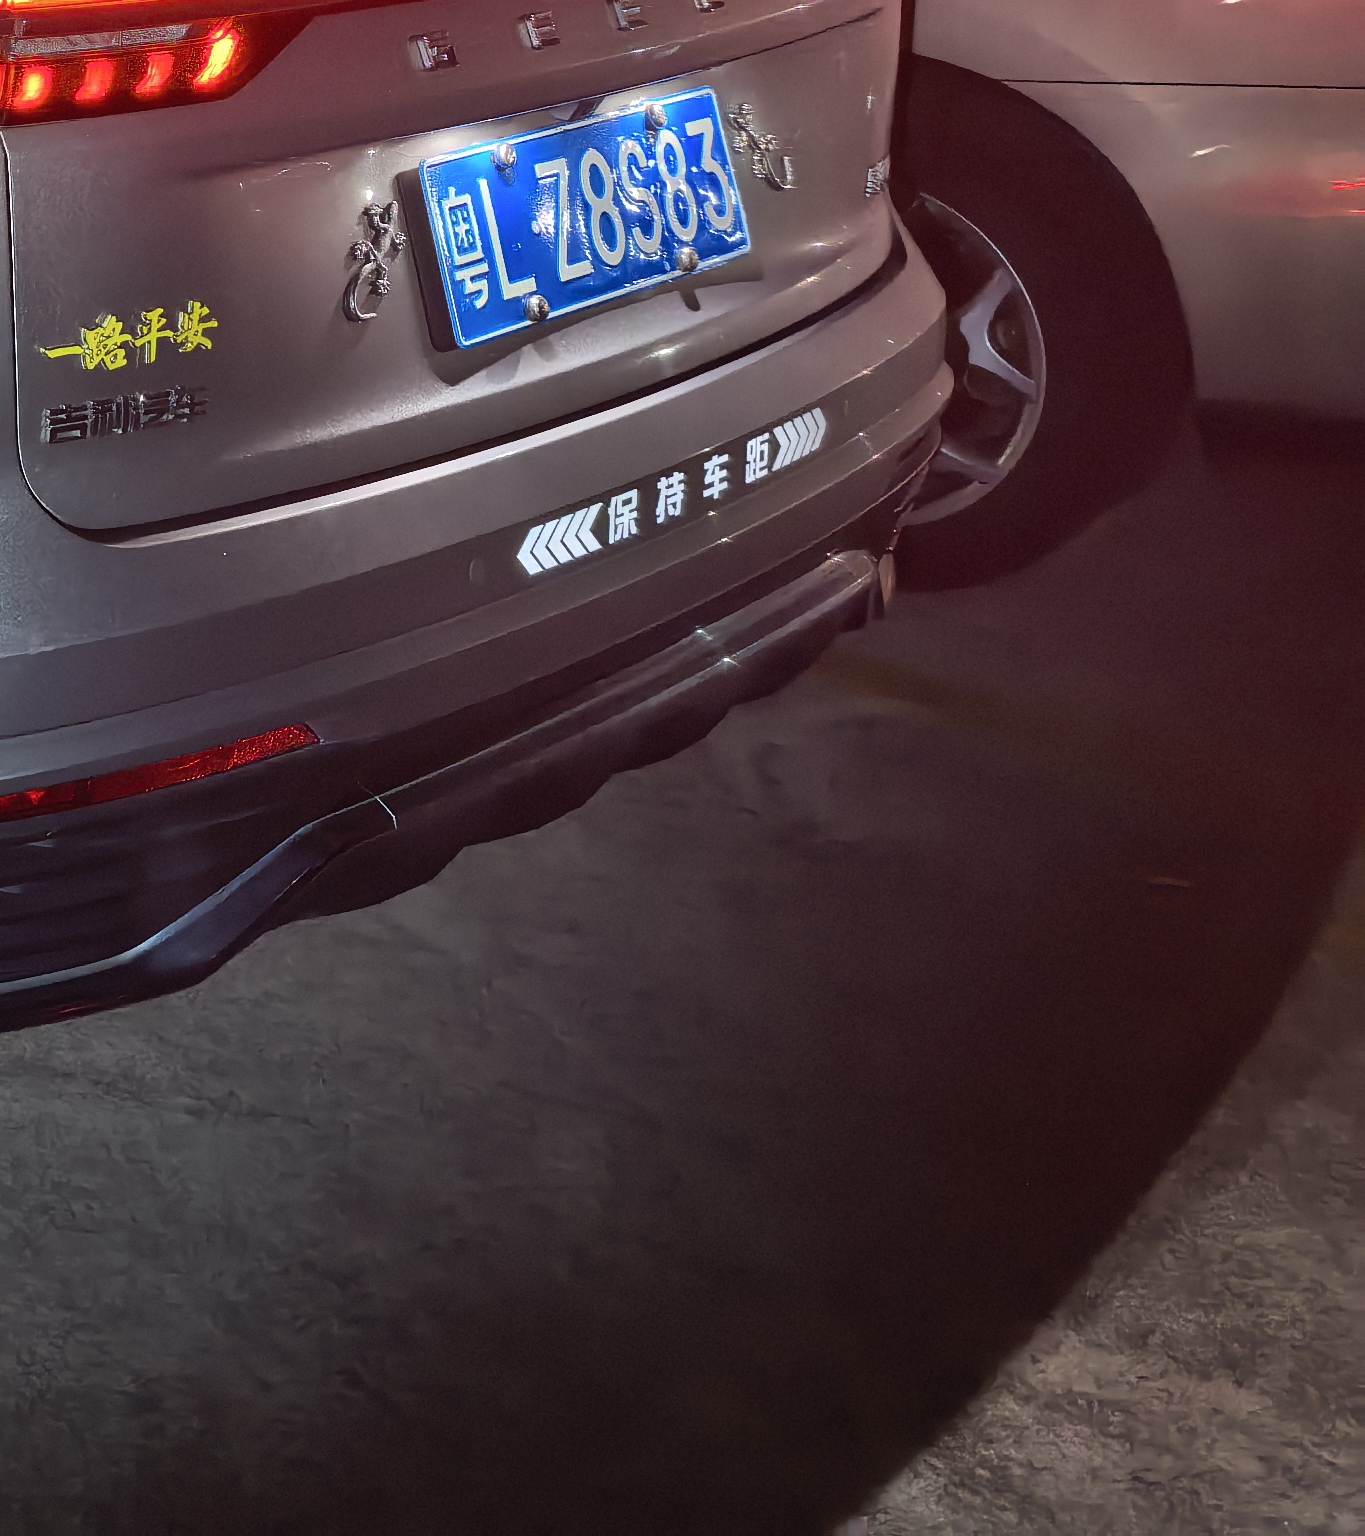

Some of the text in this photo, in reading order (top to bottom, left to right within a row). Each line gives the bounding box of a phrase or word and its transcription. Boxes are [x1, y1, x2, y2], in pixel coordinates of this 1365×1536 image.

[40, 300, 218, 371] 一路平安
[607, 432, 770, 544] 保持车距
